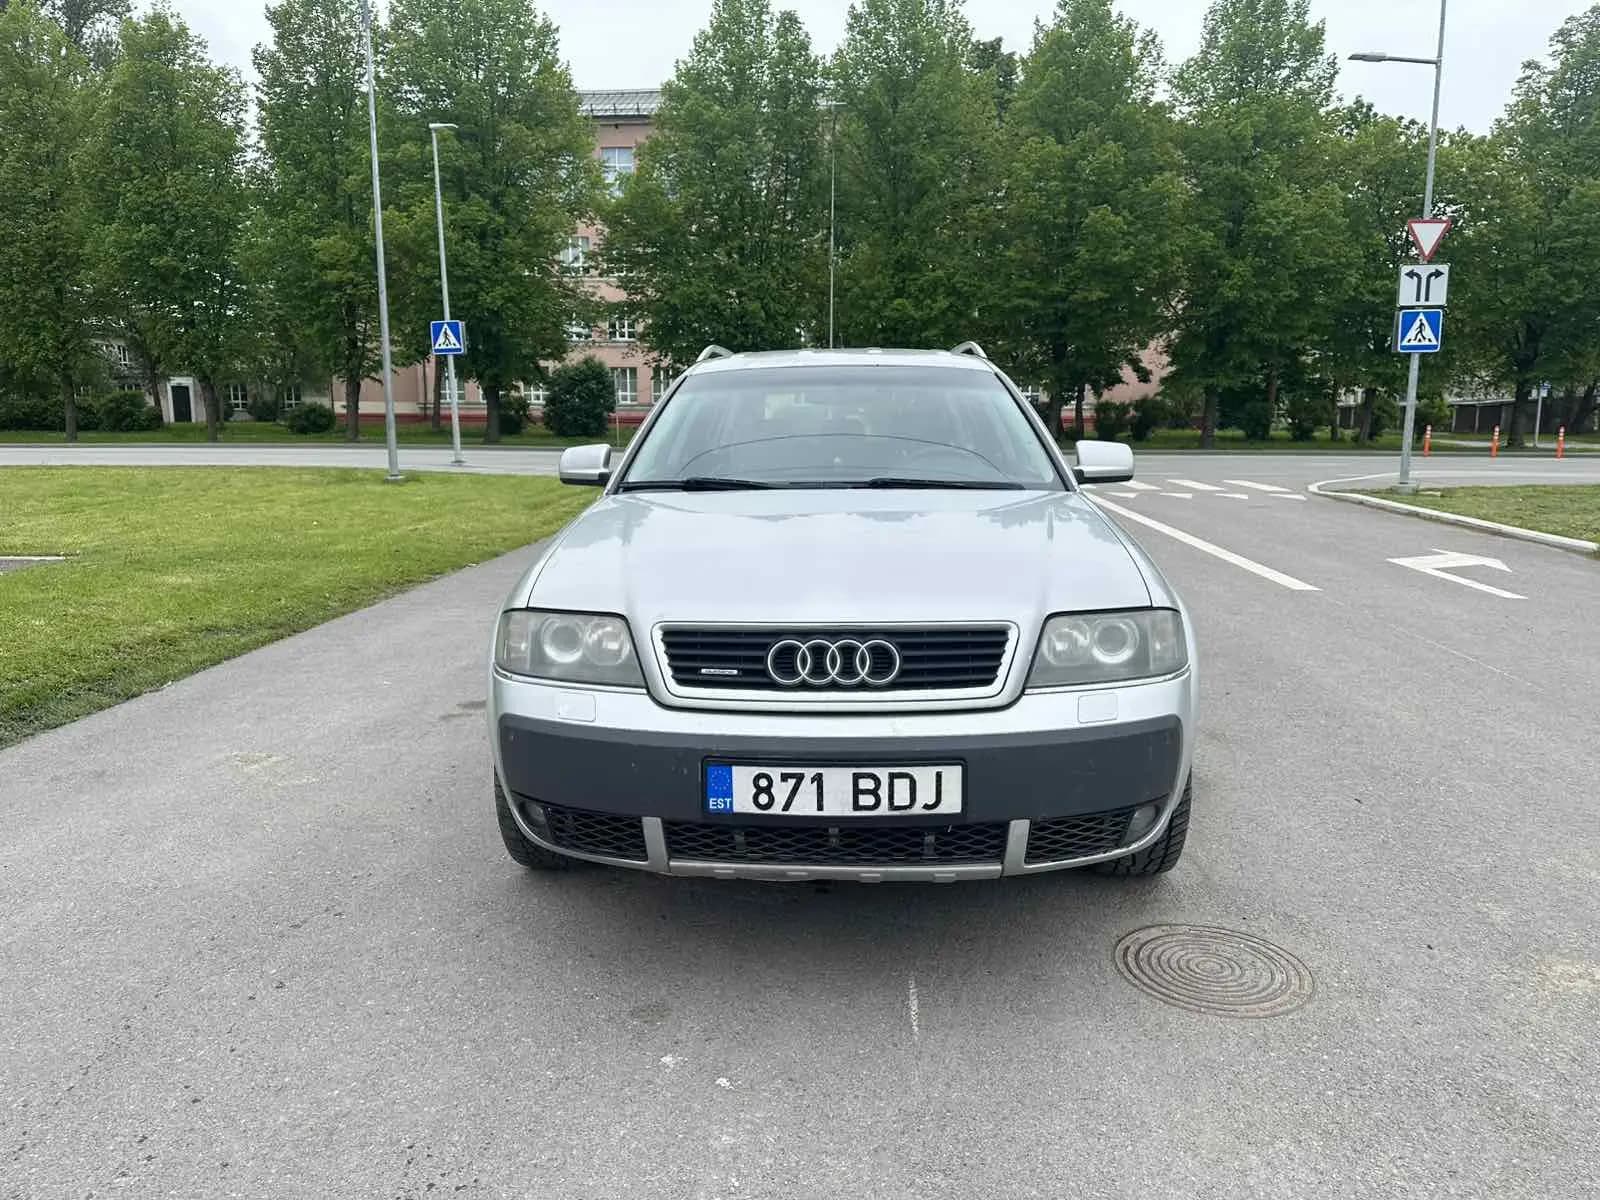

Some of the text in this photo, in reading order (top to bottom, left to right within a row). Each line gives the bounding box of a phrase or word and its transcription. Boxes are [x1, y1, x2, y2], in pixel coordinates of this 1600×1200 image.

[709, 798, 732, 809] EST
[752, 771, 943, 812] 871 BDJ
